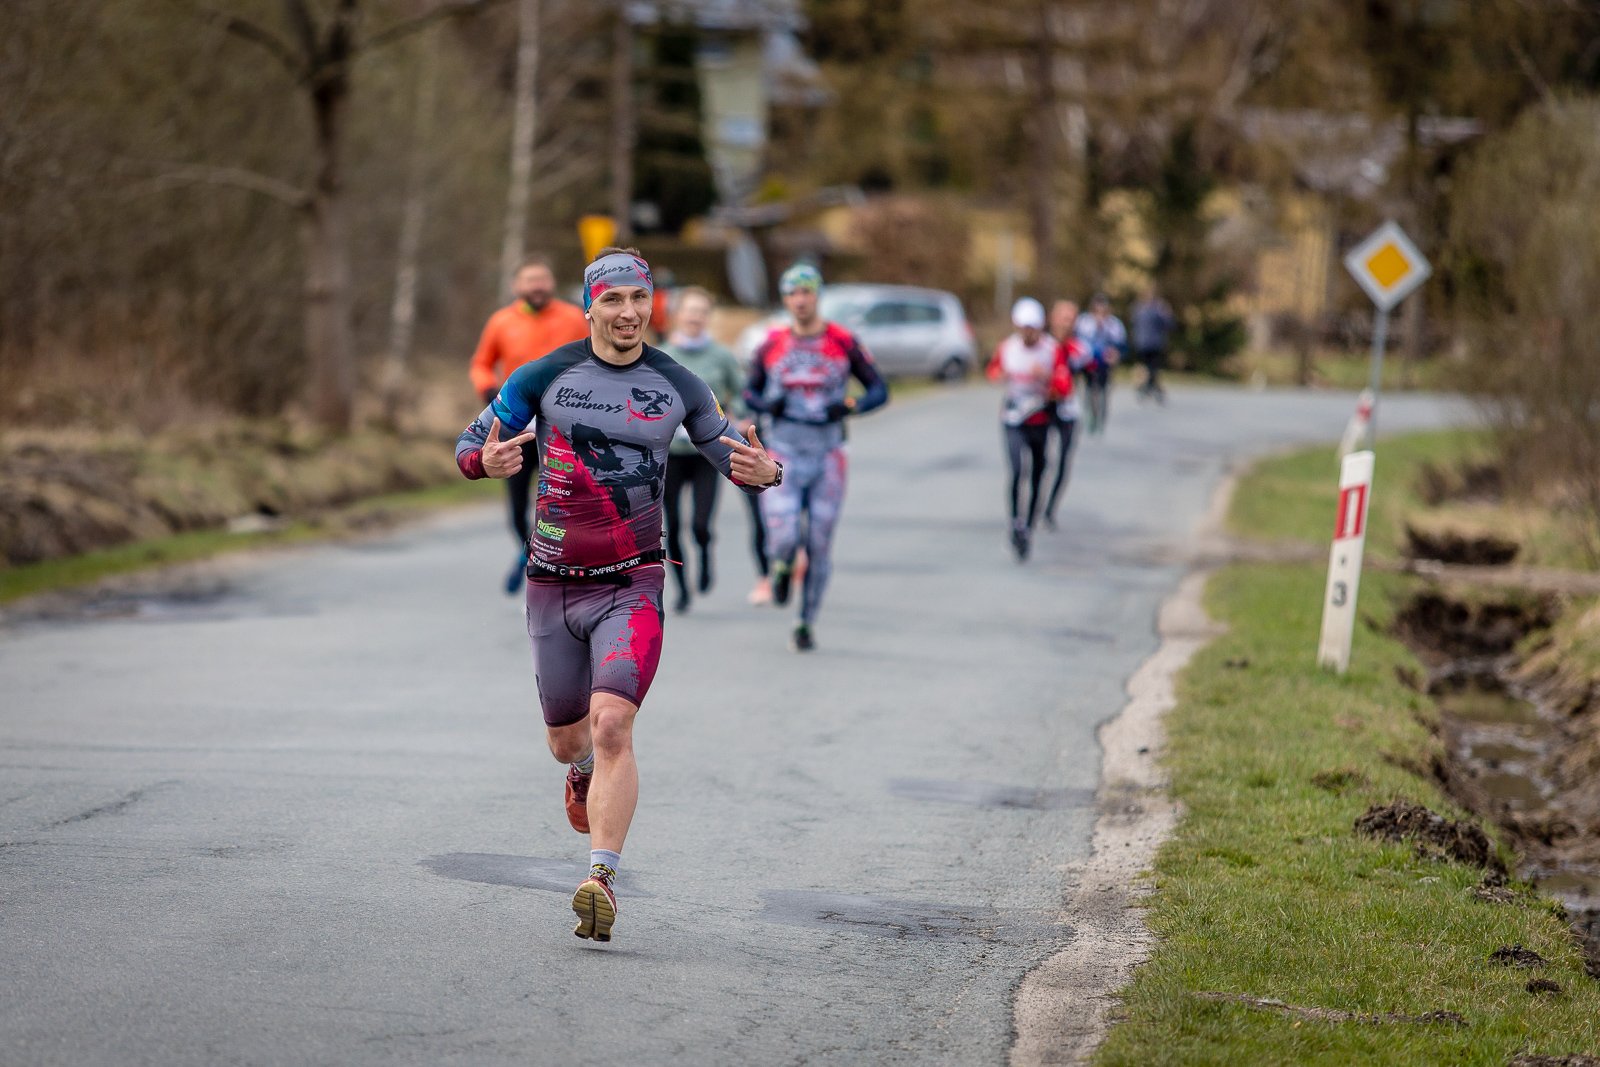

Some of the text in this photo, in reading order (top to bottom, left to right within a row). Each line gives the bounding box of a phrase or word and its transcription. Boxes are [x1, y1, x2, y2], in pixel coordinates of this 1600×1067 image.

[556, 386, 593, 402] Mad
[554, 396, 625, 414] Runners
[547, 457, 575, 473] abc
[616, 557, 640, 570] SPORT
[1331, 580, 1348, 608] 3
